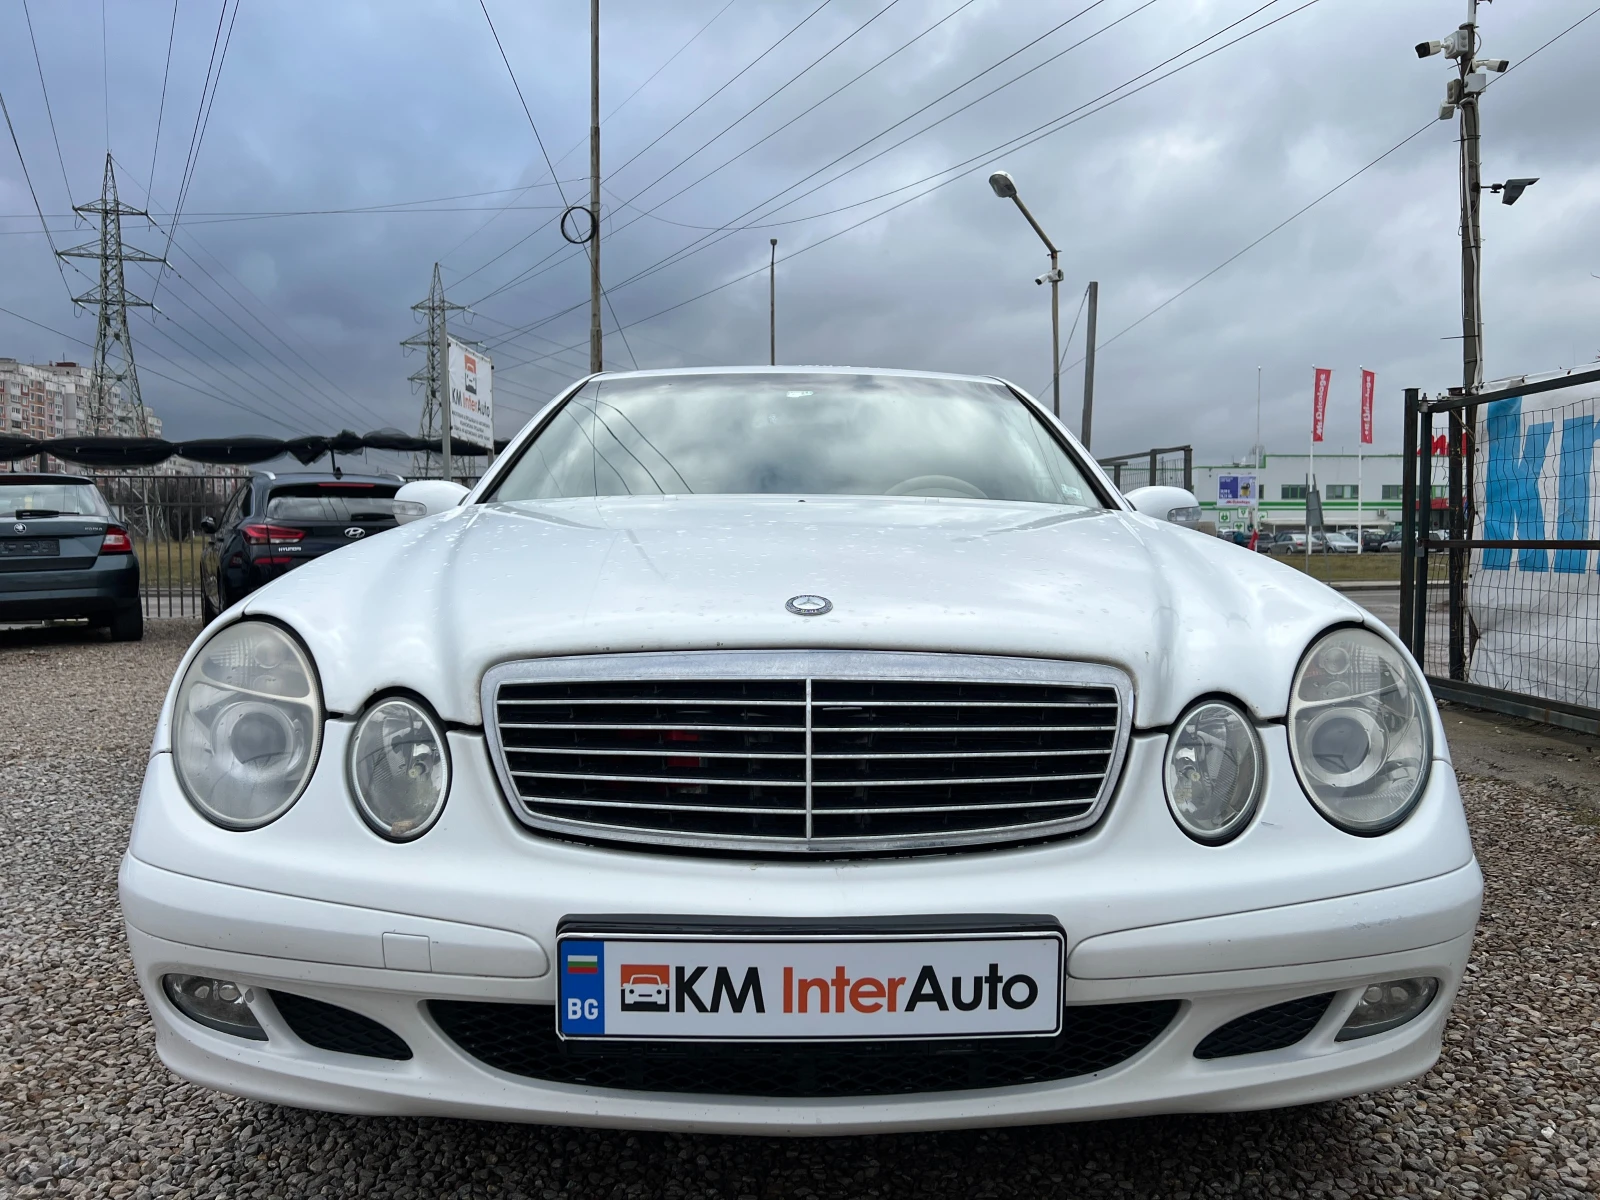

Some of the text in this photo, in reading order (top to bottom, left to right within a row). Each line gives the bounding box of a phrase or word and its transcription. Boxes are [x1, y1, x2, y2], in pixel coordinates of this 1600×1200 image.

[452, 388, 490, 417] KM InterAuto
[675, 963, 1039, 1014] KM InterAuto
[567, 998, 599, 1020] BG
